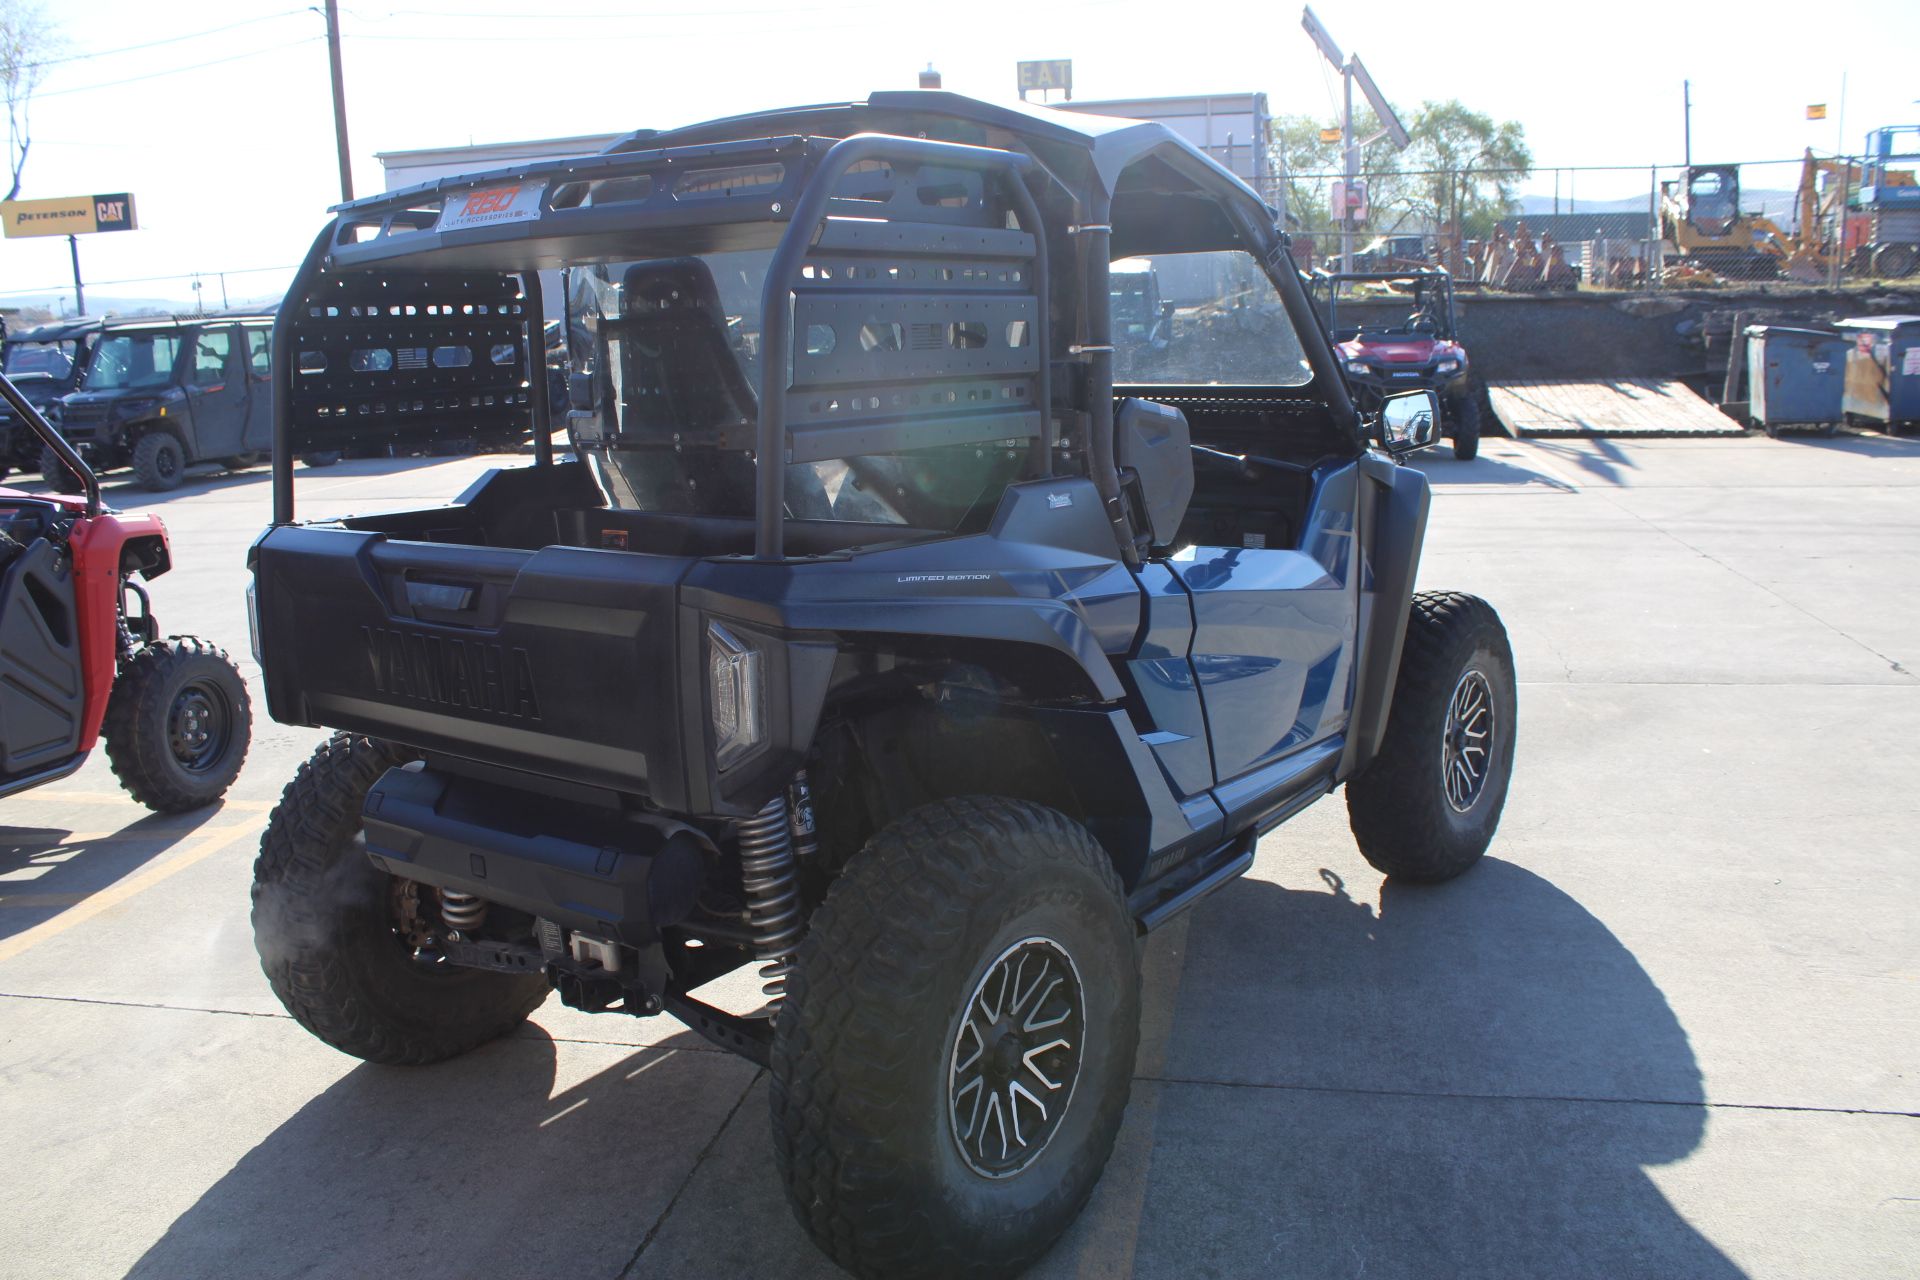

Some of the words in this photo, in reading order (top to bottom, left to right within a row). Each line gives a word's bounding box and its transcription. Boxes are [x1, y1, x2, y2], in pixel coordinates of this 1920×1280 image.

[1020, 61, 1071, 87] EAT
[17, 209, 88, 225] PETERSON
[97, 201, 124, 223] CAT
[898, 575, 945, 583] LIMITED
[360, 625, 543, 721] YAMAHA
